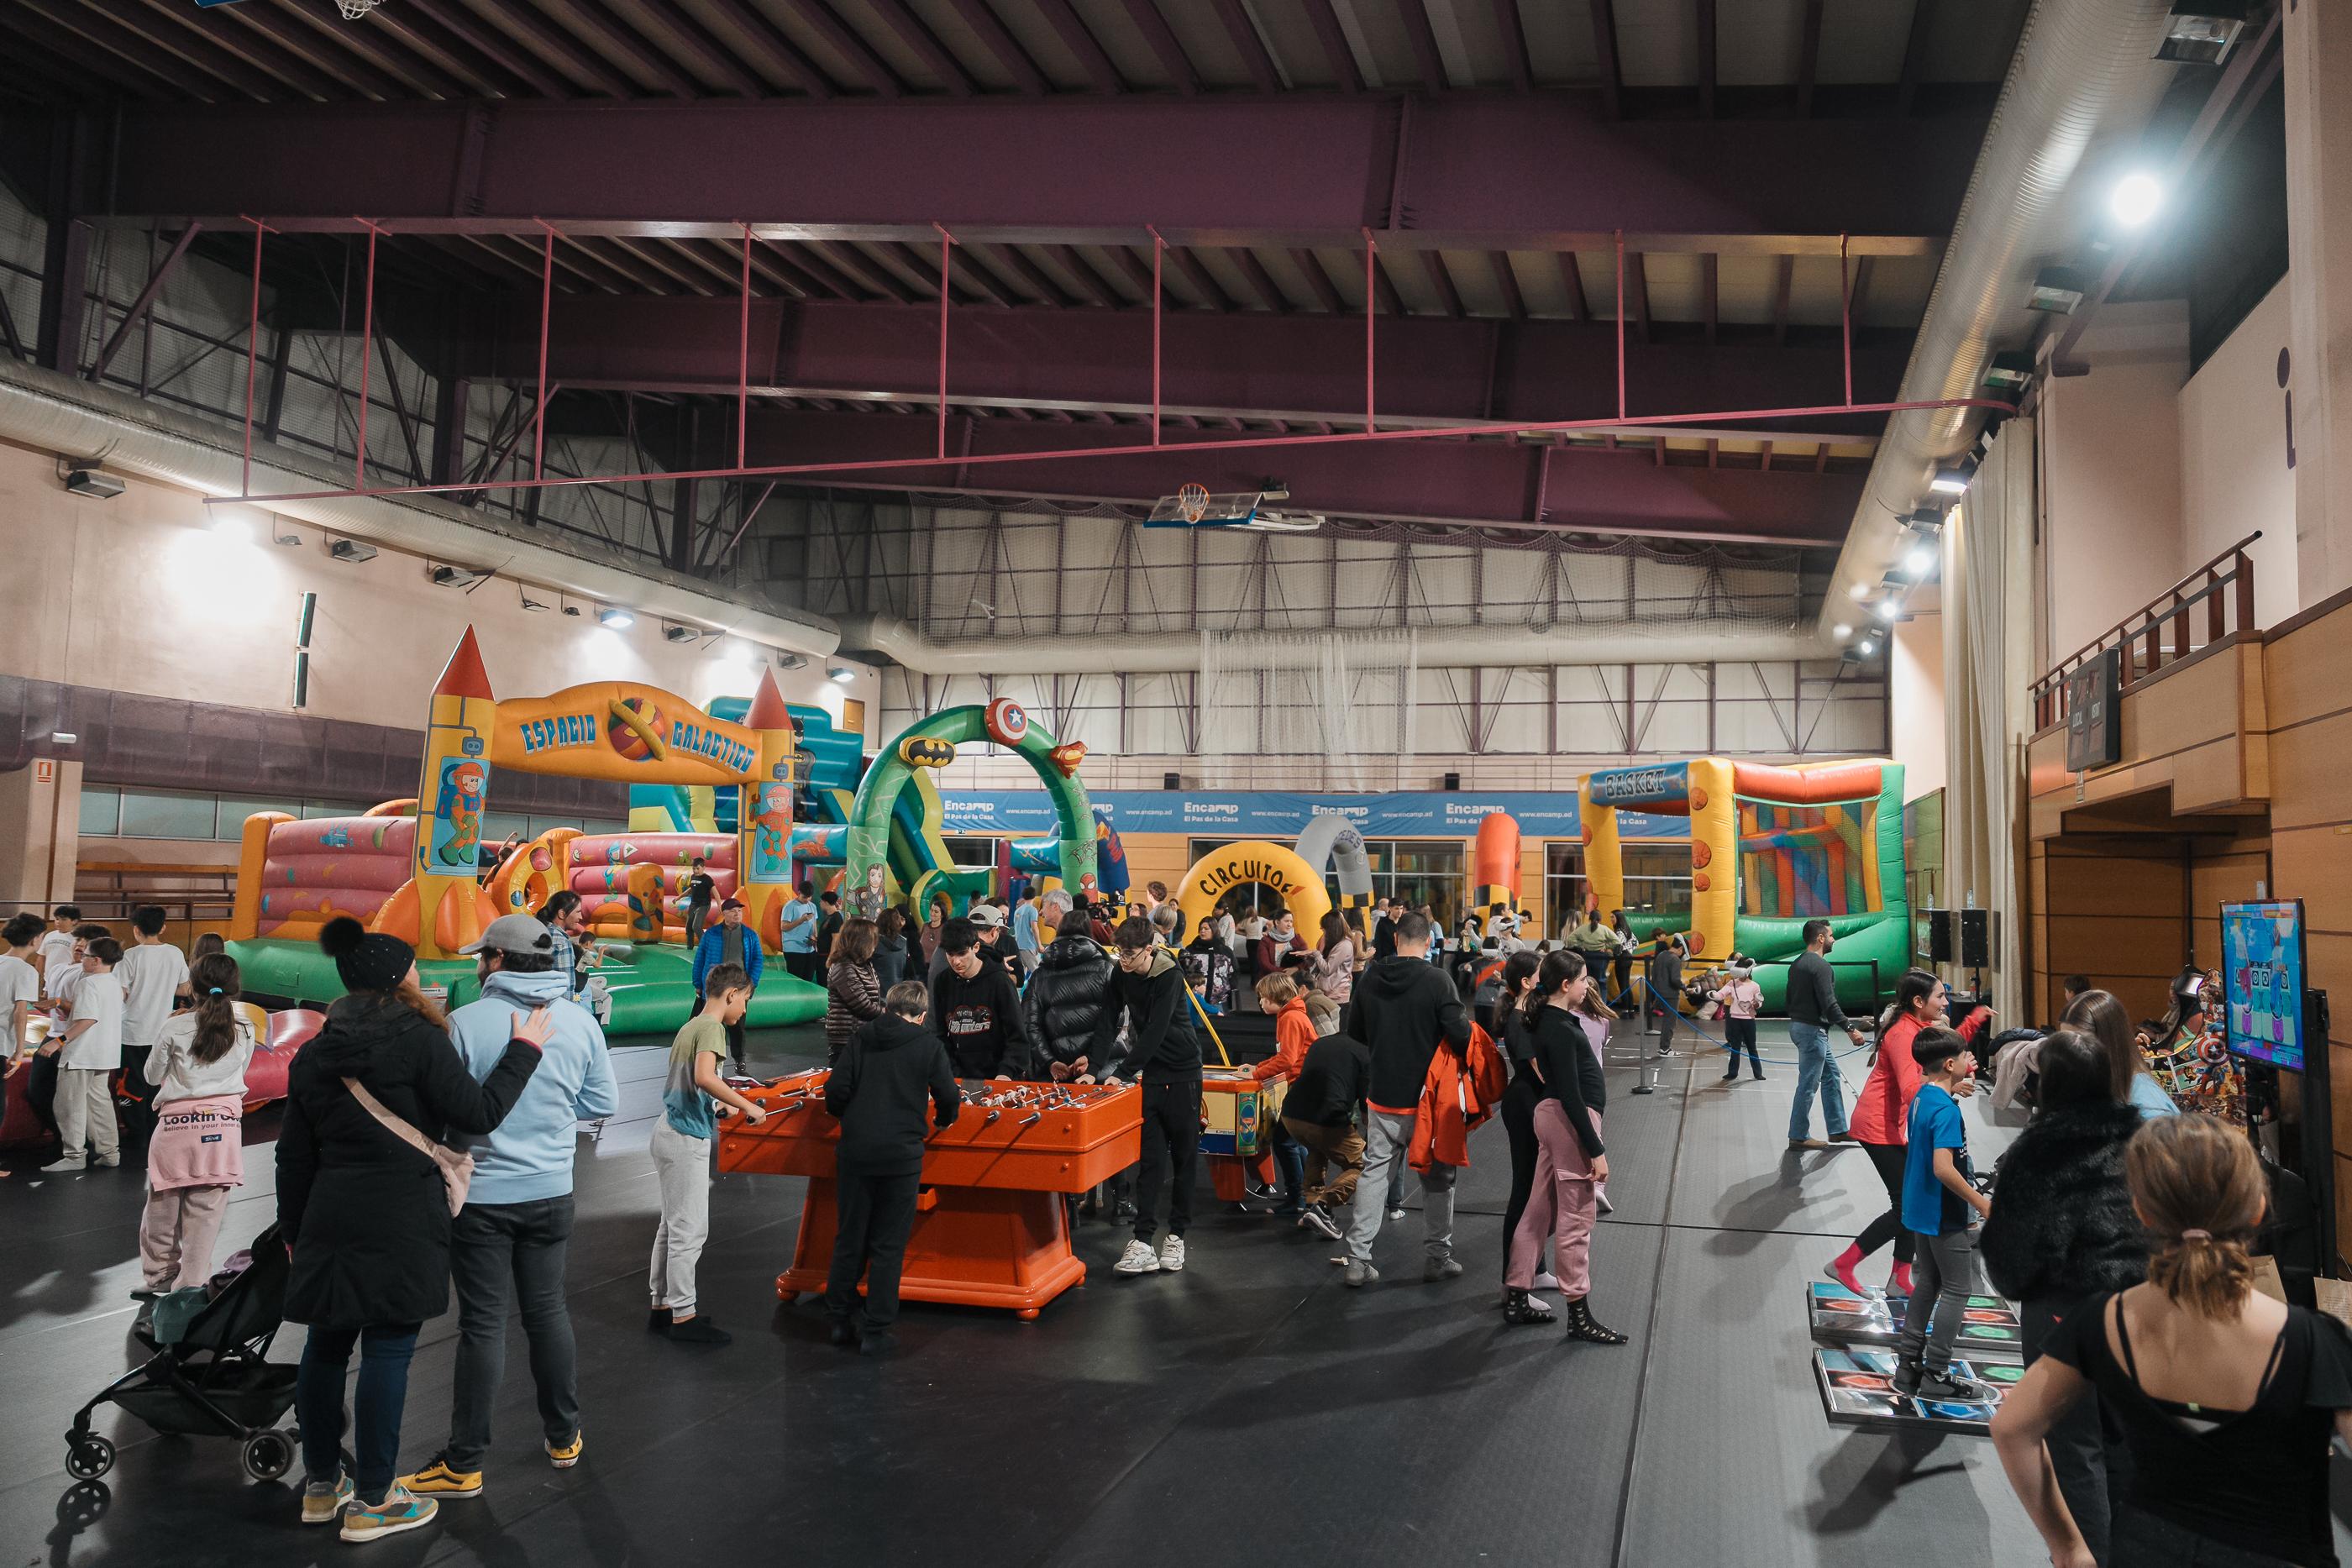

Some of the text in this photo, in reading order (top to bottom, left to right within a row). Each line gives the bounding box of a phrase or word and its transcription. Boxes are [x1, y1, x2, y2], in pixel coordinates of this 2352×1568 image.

[519, 714, 755, 774] ESPACIO GALACTICO
[1605, 768, 1666, 798] BASKET
[944, 800, 995, 812] Encamp
[1184, 802, 1239, 815] Encamp
[1312, 805, 1369, 817] Encamp
[1446, 803, 1505, 814] Encamp
[1252, 810, 1300, 818] www.encamp.ad
[1382, 810, 1433, 819] www.encamp.ad
[1519, 810, 1572, 819] www.encamp.ad
